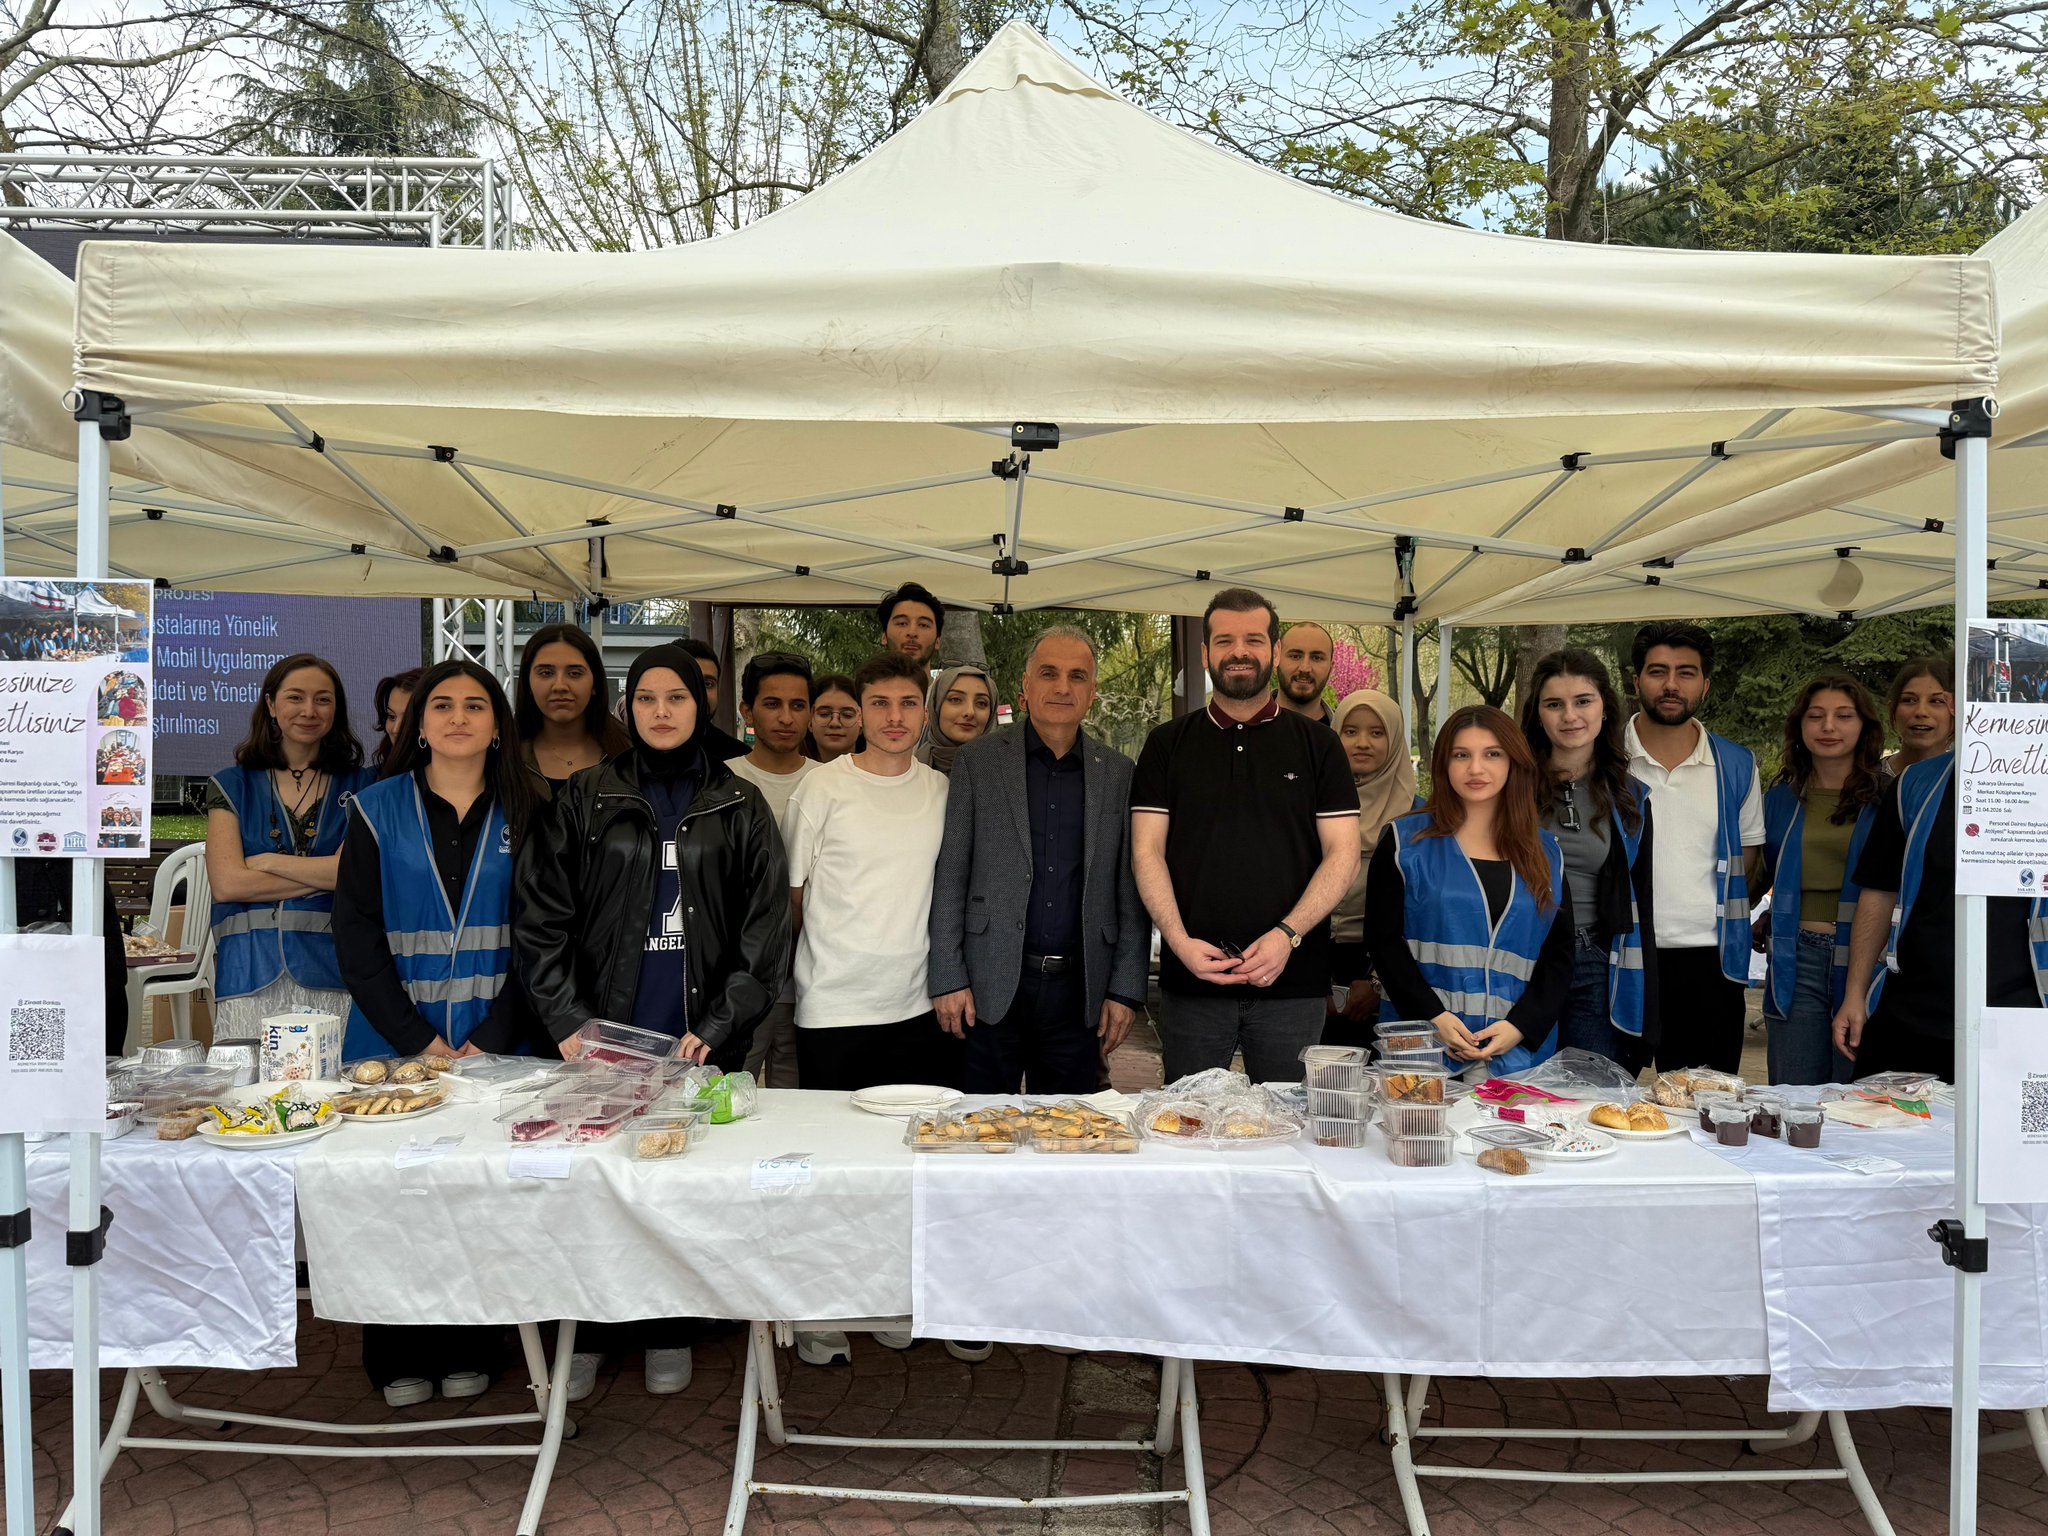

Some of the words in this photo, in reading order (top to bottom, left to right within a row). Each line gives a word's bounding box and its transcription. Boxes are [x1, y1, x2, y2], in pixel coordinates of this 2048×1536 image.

[224, 614, 280, 638] Yönelik
[156, 646, 198, 669] Mobil
[189, 684, 208, 702] ve
